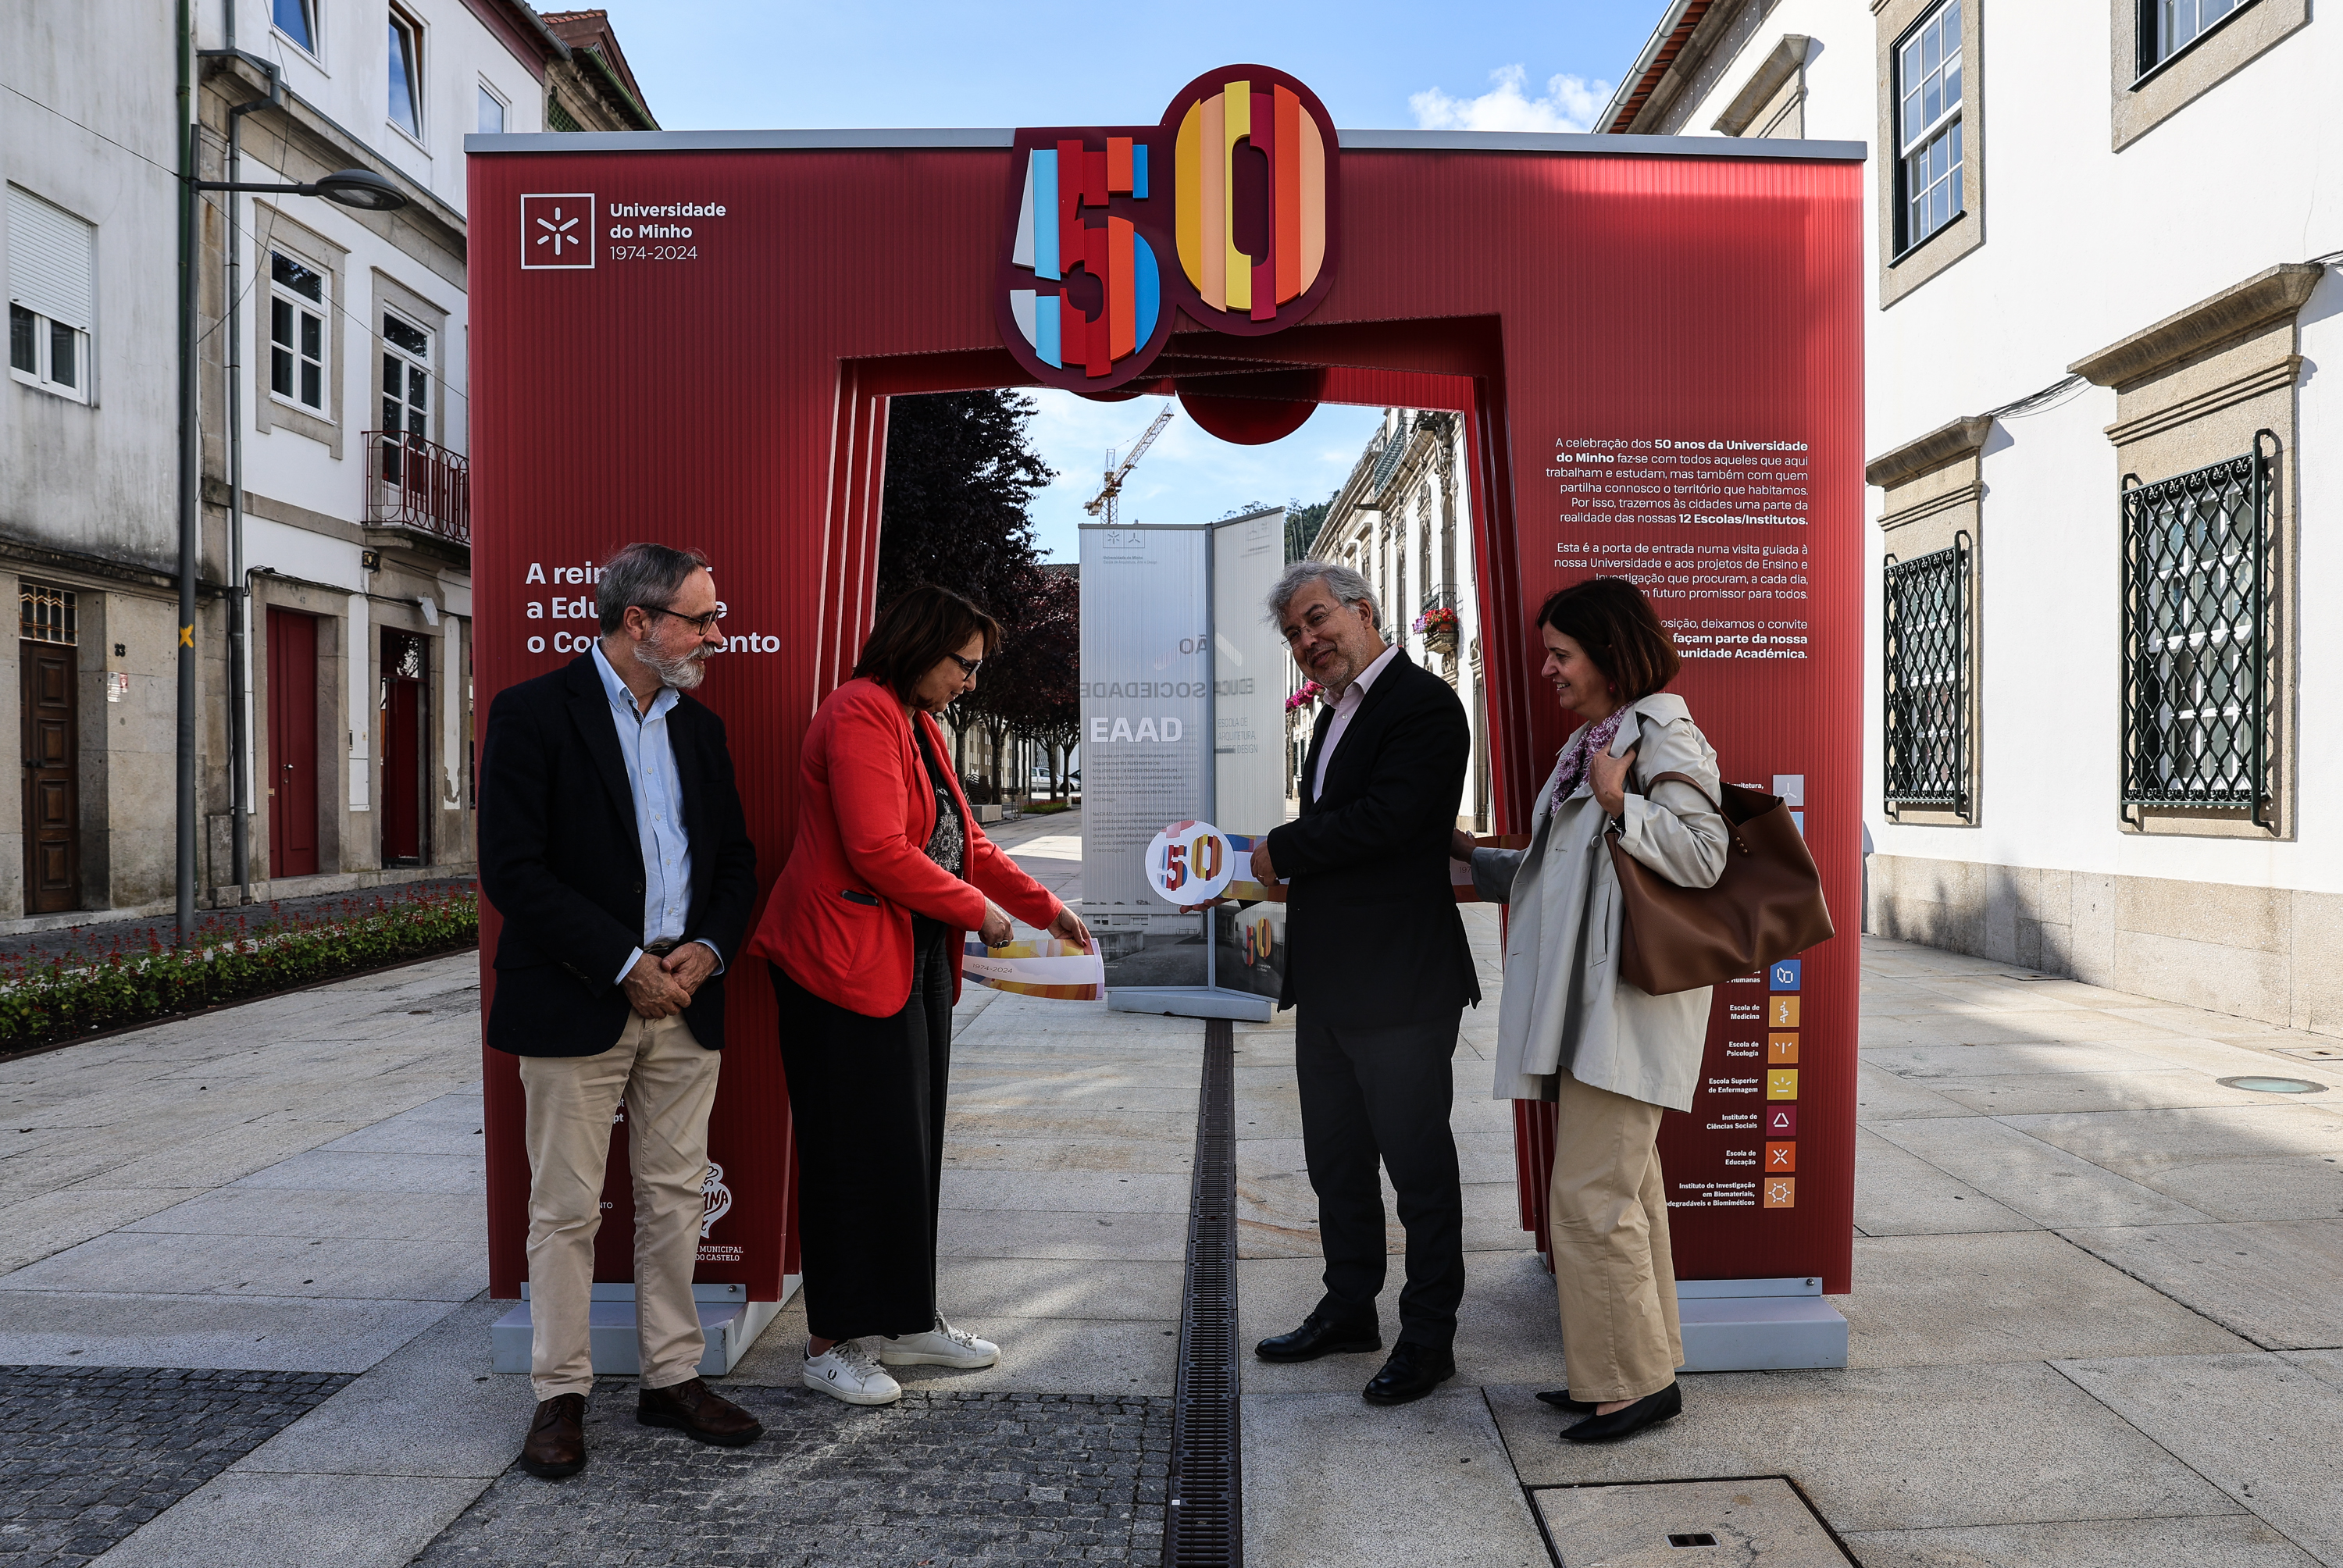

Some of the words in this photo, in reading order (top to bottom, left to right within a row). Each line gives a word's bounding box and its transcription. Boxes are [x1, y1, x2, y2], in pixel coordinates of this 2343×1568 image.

[610, 201, 726, 217] Universidade
[609, 224, 633, 239] do
[639, 223, 693, 239] Minho
[1009, 80, 1326, 377] 50
[609, 245, 698, 260] 1974-2024
[1555, 437, 1564, 447] A
[1565, 437, 1628, 451] celebração
[1631, 438, 1652, 449] dos
[1654, 439, 1672, 449] 50
[1674, 441, 1706, 450] anos
[1707, 439, 1724, 450] da
[1726, 440, 1809, 451] Universidade
[1556, 451, 1573, 463] do
[1575, 452, 1615, 463] Minho
[1617, 452, 1649, 464] faz-se
[1651, 455, 1677, 464] com
[1679, 454, 1712, 465] todos
[1714, 454, 1758, 467] aqueles
[1760, 457, 1782, 468] que
[1785, 455, 1808, 468] aqui
[1545, 467, 1603, 478] trabalham
[1606, 469, 1613, 478] e
[1615, 468, 1667, 479] estudam,
[1670, 470, 1694, 479] mas
[1696, 469, 1745, 480] também
[1747, 472, 1773, 480] com
[1775, 472, 1808, 483] quem
[1560, 482, 1602, 494] partilha
[1604, 484, 1661, 494] connosco
[1663, 485, 1671, 494] o
[1673, 483, 1721, 494] território
[1724, 486, 1746, 497] que
[1748, 484, 1809, 496] habitamos.
[1571, 497, 1590, 508] Por
[1592, 497, 1617, 509] isso,
[1618, 498, 1671, 508] trazemos
[1673, 497, 1686, 509] às
[1689, 498, 1733, 509] cidades
[1735, 501, 1760, 510] uma
[1763, 501, 1792, 512] parte
[1794, 500, 1808, 511] da
[1560, 511, 1612, 522] realidade
[1614, 512, 1635, 523] das
[1637, 515, 1677, 523] nossas
[1678, 513, 1692, 524] 12
[1694, 513, 1809, 526] Escolas/Institutos.
[1557, 542, 1580, 553] Esta
[1582, 542, 1590, 553] é
[1592, 544, 1599, 553] a
[1602, 543, 1632, 555] porta
[1634, 543, 1649, 554] de
[1652, 543, 1695, 554] entrada
[1697, 545, 1730, 554] numa
[1731, 543, 1760, 554] visita
[1762, 544, 1799, 557] guiada
[1801, 543, 1808, 555] à
[1554, 559, 1587, 568] nossa
[1590, 558, 1662, 568] Universidade
[1664, 560, 1672, 568] e
[1674, 560, 1695, 568] aos
[1697, 558, 1742, 571] projetos
[1745, 558, 1760, 569] de
[1762, 559, 1799, 569] Ensino
[1801, 561, 1808, 570] e
[525, 562, 547, 584] A
[1667, 575, 1689, 586] que
[1692, 575, 1749, 586] procuram,
[1751, 576, 1758, 584] a
[1760, 573, 1787, 584] cada
[1789, 573, 1809, 586] dia,
[1652, 587, 1686, 598] futuro
[1689, 588, 1746, 600] promissor
[1748, 590, 1772, 600] para
[1774, 588, 1809, 600] todos.
[526, 601, 543, 618] a
[1701, 618, 1755, 629] deixamos
[1757, 621, 1765, 629] o
[1767, 618, 1808, 629] convite
[526, 636, 546, 653] o
[1672, 633, 1713, 646] façam
[1715, 634, 1749, 646] parte
[1751, 633, 1767, 644] da
[1770, 636, 1808, 644] nossa
[1734, 647, 1808, 659] Académica.
[1218, 718, 1239, 728] ESCOLA
[1240, 717, 1248, 727] DE
[1089, 717, 1182, 743] EAAD
[1237, 743, 1258, 754] DESIGN
[1157, 834, 1223, 892] 50
[1242, 917, 1271, 967] 50
[972, 963, 1013, 974] 1974-2024
[1726, 1049, 1759, 1058] Psicologia
[1731, 1077, 1759, 1085] Superior
[1724, 1158, 1756, 1167] Educação
[1716, 1181, 1756, 1190] Investigação
[1714, 1190, 1756, 1199] Biomateriais,
[705, 1253, 740, 1262] CASTELO
